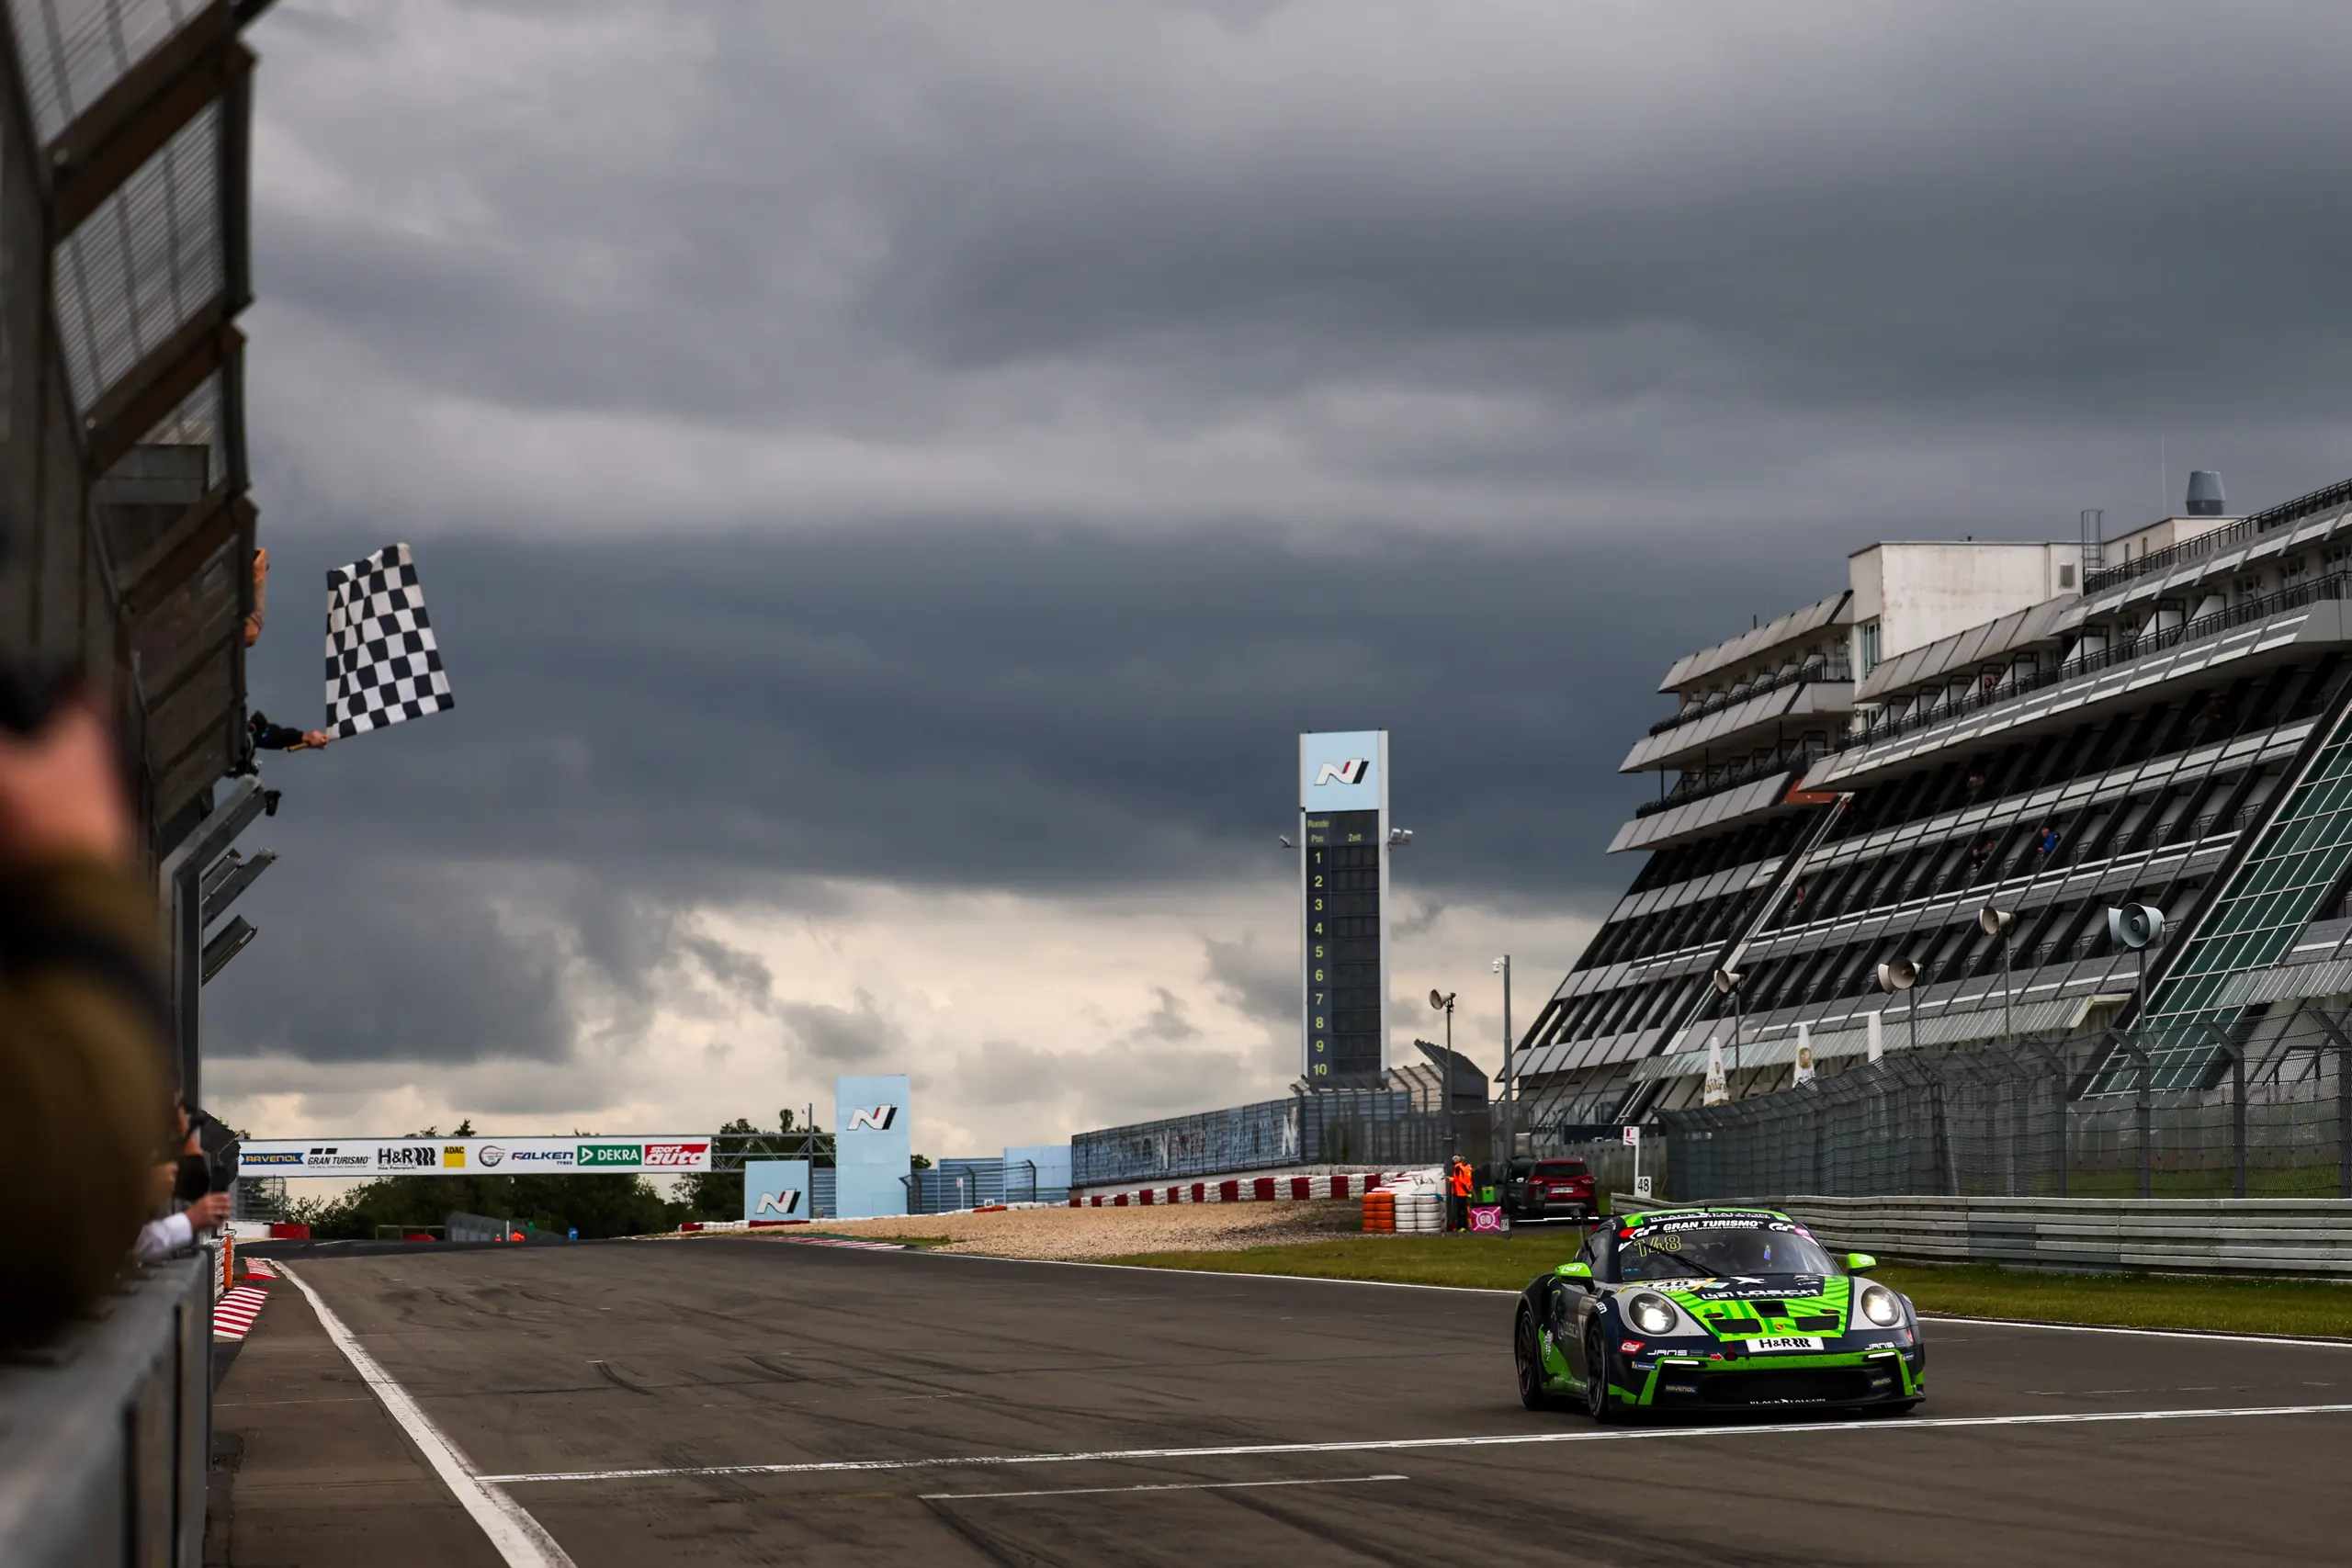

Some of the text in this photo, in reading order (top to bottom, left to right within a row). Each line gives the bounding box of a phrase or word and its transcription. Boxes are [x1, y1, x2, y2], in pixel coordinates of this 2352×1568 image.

[1348, 833, 1362, 842] Zeit
[1315, 852, 1321, 863] 1
[1315, 875, 1323, 887] 2
[1315, 899, 1323, 911] 3
[1315, 922, 1323, 934] 4
[1316, 946, 1323, 958] 5
[1316, 969, 1323, 981] 6
[1316, 993, 1323, 1005] 7
[1316, 1017, 1324, 1029] 8
[1316, 1040, 1324, 1052] 9
[1313, 1064, 1328, 1076] 10
[378, 1147, 414, 1165] H&R
[598, 1149, 639, 1160] DEKRA
[650, 1145, 683, 1155] sport
[333, 1156, 368, 1165] TURISMO
[645, 1152, 707, 1165] auto
[1637, 1179, 1649, 1192] 48
[1479, 1214, 1491, 1224] 60
[1663, 1222, 1699, 1231] GRAN
[1634, 1235, 1682, 1257] 148
[1759, 1337, 1792, 1348] H&R
